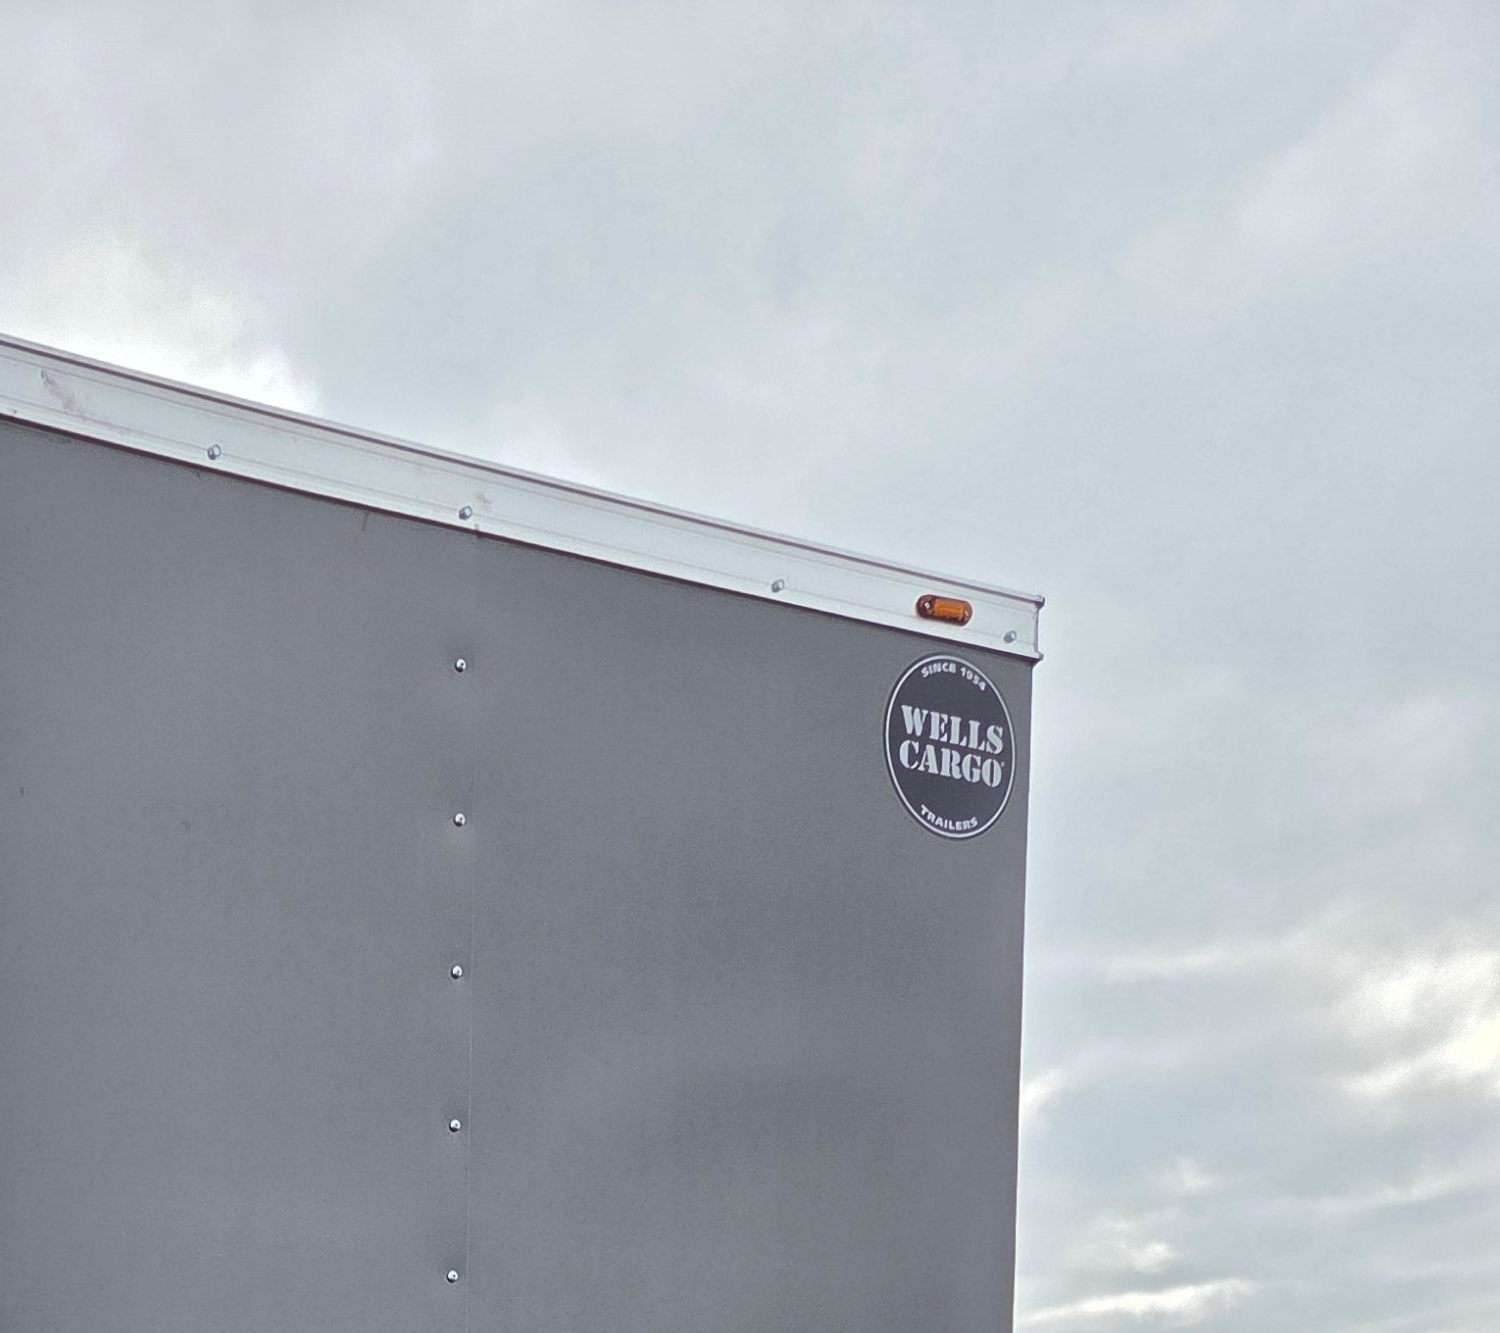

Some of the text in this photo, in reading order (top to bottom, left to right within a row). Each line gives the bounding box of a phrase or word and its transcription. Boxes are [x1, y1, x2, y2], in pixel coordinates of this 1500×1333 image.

[921, 662, 987, 692] SINCE 1954
[901, 704, 1004, 755] WELLS
[899, 739, 1003, 788] CARGO
[920, 804, 979, 831] TRAILERS
